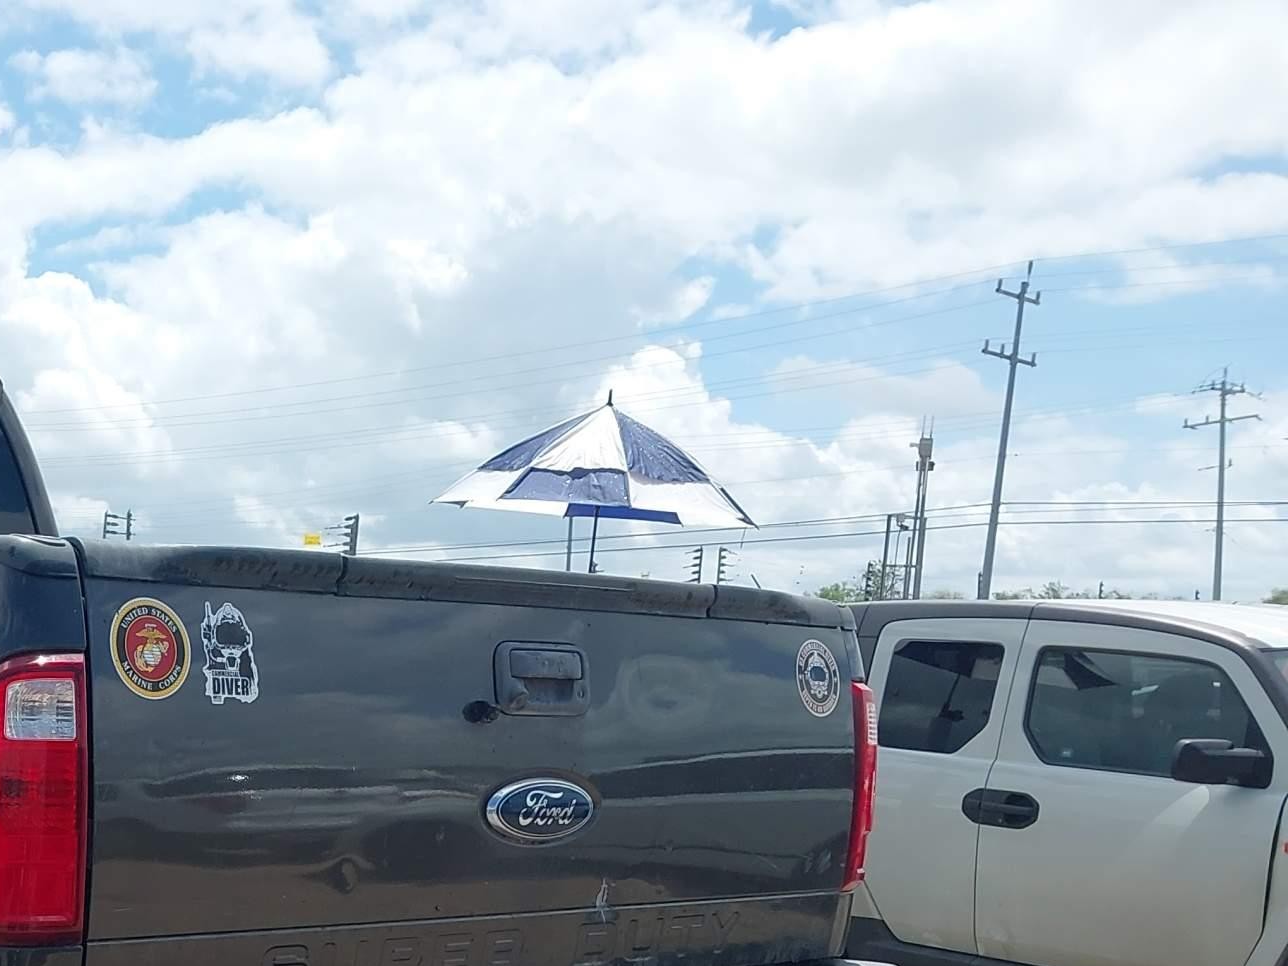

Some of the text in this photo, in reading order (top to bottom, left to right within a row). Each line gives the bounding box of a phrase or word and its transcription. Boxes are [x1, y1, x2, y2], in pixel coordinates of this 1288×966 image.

[121, 607, 178, 633] UNITED STATES
[122, 660, 183, 691] MARINE CORPS
[212, 677, 250, 696] DIVER
[518, 790, 576, 826] Ford
